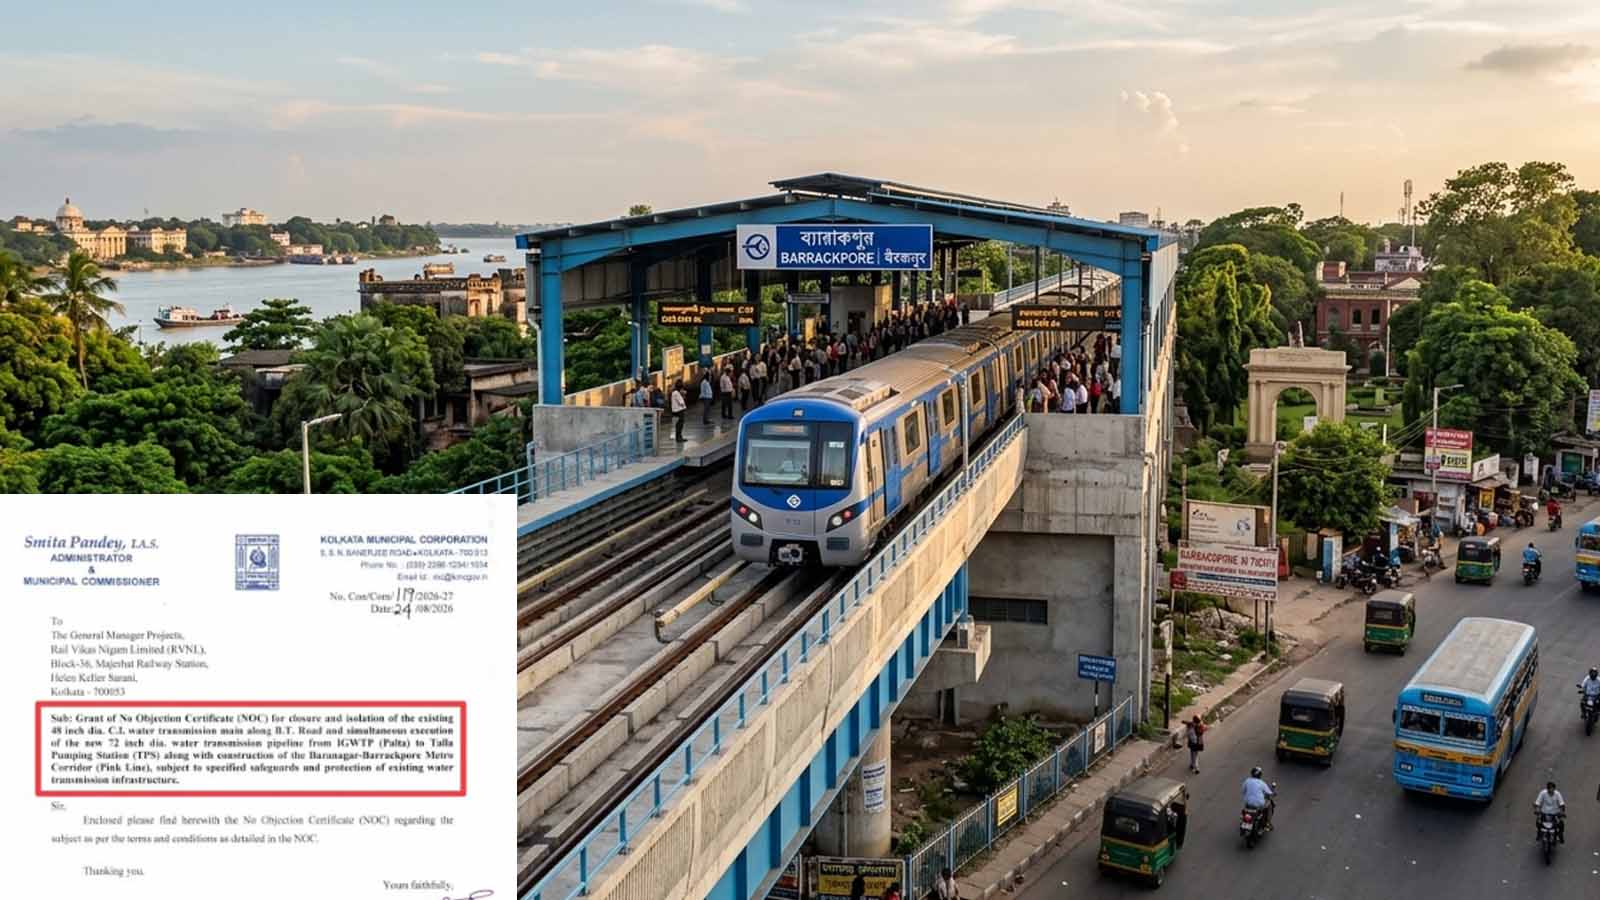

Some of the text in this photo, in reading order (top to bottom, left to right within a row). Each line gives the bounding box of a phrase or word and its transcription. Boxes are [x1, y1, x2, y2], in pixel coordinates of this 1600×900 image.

[781, 252, 874, 264] BARRACKPORE
[24, 535, 158, 553] Smita Pandey, I.A.S.
[320, 535, 488, 545] KOLKATA MUNICIPAL CORPORATION
[50, 553, 133, 563] ADMINISTRATOR
[24, 576, 160, 586] MUNICIPAL COMMISSIONER
[329, 592, 346, 601] No.
[52, 617, 63, 625] To
[53, 631, 67, 639] The
[70, 631, 104, 640] General
[106, 631, 144, 642] Manager
[51, 645, 68, 654] Rail
[72, 645, 96, 654] Vikas
[98, 645, 128, 656] Nigam
[130, 645, 164, 654] Limited
[96, 659, 134, 668] Majerhat
[136, 659, 172, 668] Railway
[51, 673, 76, 682] Helen
[78, 673, 105, 683] Keller
[51, 688, 85, 696] Kolkata
[51, 713, 454, 725] Sub: Grant of No Objection Certificate (NOC) for closure and isolation of the existing
[51, 726, 62, 735] 48
[64, 726, 85, 735] inch
[87, 725, 104, 735] dia.
[128, 727, 155, 735] water
[158, 726, 217, 735] transmission
[247, 726, 272, 736] along
[275, 726, 294, 735] B.T.
[298, 726, 323, 735] Road
[326, 726, 344, 735] and
[346, 726, 407, 735] simultaneous
[409, 726, 453, 735] execution
[51, 737, 453, 749] of the new 72 inch dia. water transmission pipeline from IGWTP (Palta) to Talla
[51, 751, 93, 762] Pumping
[96, 751, 129, 760] Station
[132, 751, 160, 761] (TPS)
[164, 751, 190, 762] along
[192, 751, 214, 760] with
[216, 751, 274, 760] construction
[277, 751, 288, 760] of
[291, 751, 305, 760] the
[425, 750, 454, 760] Metro
[51, 763, 92, 772] Corridor
[95, 763, 121, 772] (Pink
[156, 763, 190, 774] subject
[193, 764, 202, 772] to
[206, 762, 247, 774] specified
[250, 763, 299, 774] safeguards
[303, 763, 321, 772] and
[324, 764, 372, 774] protection
[375, 762, 386, 772] of
[388, 762, 424, 774] existing
[427, 764, 454, 772] water
[51, 775, 179, 785] transmission infrastructure.
[84, 815, 453, 826] Enclosed please find herewith the No Objection Certificate (NOC) regarding the
[51, 834, 81, 845] subject
[95, 836, 109, 845] per
[111, 834, 124, 843] the
[127, 835, 150, 843] terms
[154, 834, 169, 843] and
[172, 834, 217, 843] conditions
[231, 834, 265, 843] detailed
[268, 834, 276, 843] in
[279, 834, 291, 843] the
[84, 866, 124, 878] Thanking
[383, 880, 408, 890] Yours
